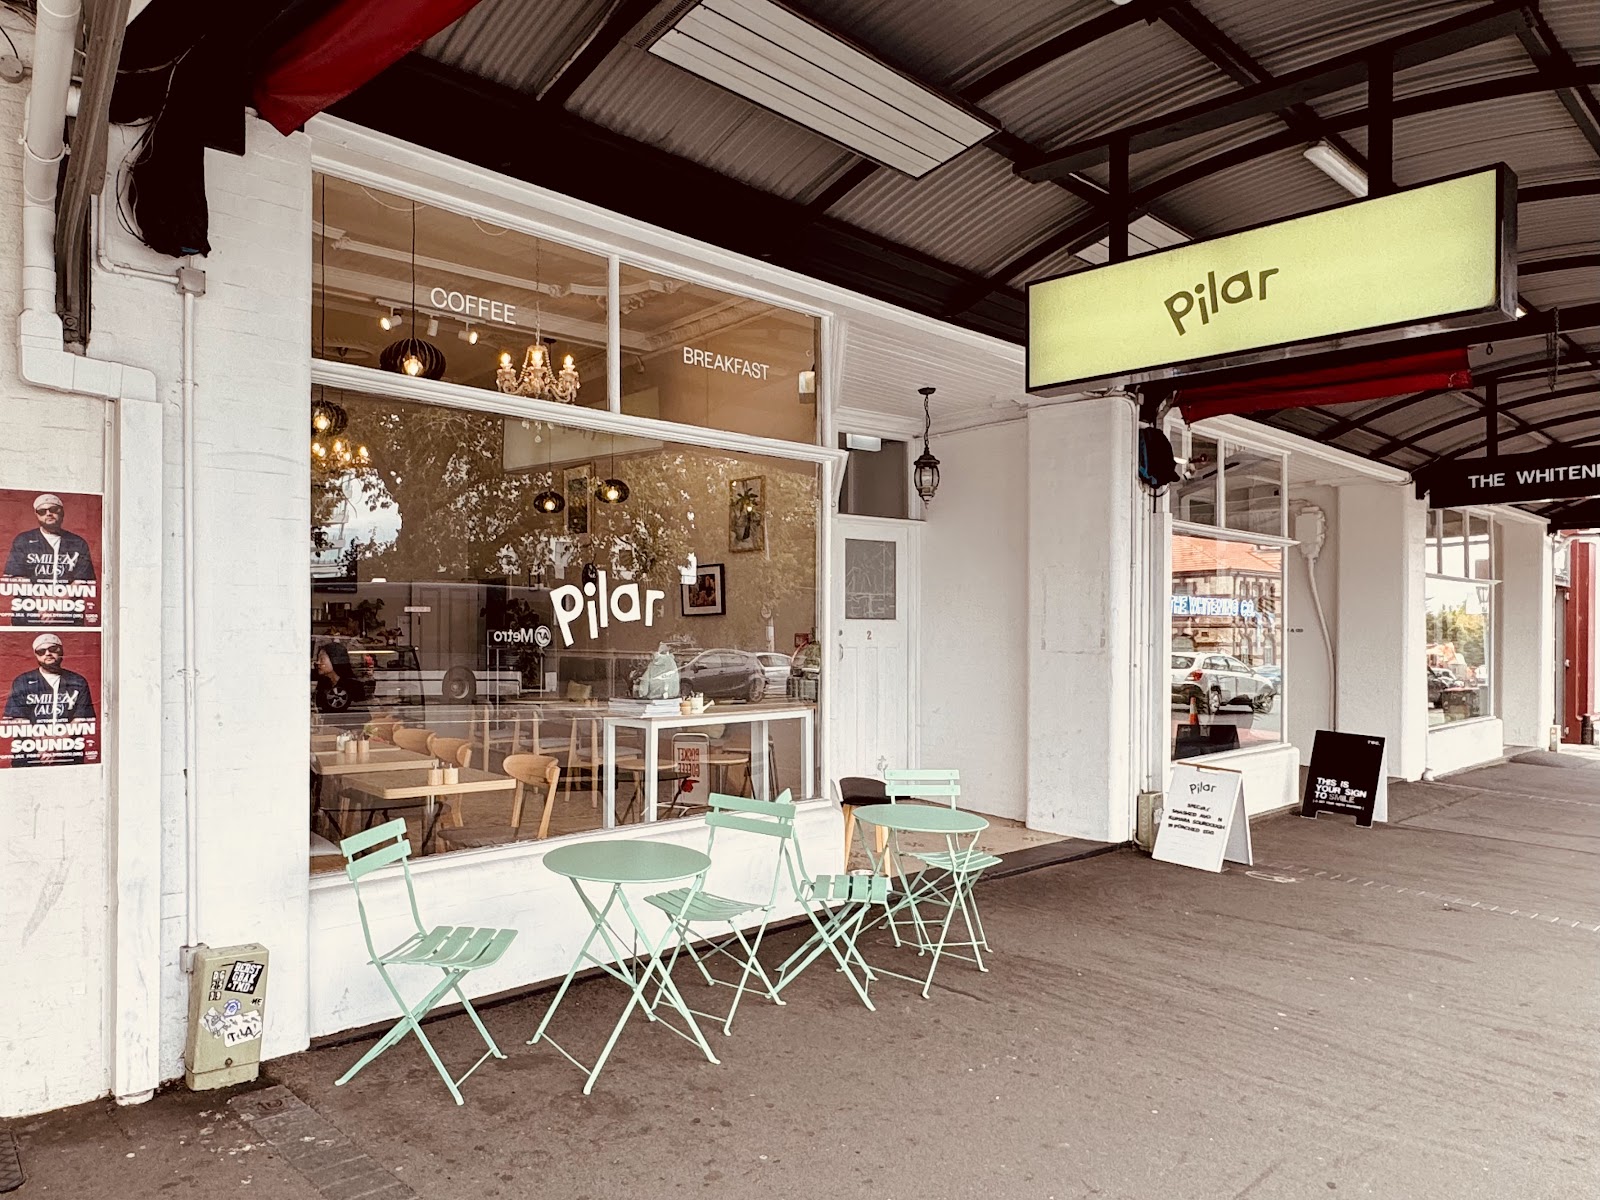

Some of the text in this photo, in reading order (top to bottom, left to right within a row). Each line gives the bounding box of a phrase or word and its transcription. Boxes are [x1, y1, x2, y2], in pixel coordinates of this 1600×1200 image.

[429, 287, 516, 325] COFFEE
[683, 346, 770, 380] BREAKFAST
[1467, 472, 1505, 488] THE
[0, 583, 96, 598] UNKNOWN
[11, 598, 86, 612] SOUNDS
[866, 630, 872, 640] 2
[0, 723, 96, 738] UNKNOWN
[11, 737, 86, 753] SOUNDS
[1316, 777, 1349, 788] THIS IS
[1314, 791, 1355, 803] TO SMILE
[1315, 784, 1367, 798] YOUR SIGN
[1192, 819, 1225, 829] SOURDOUGH
